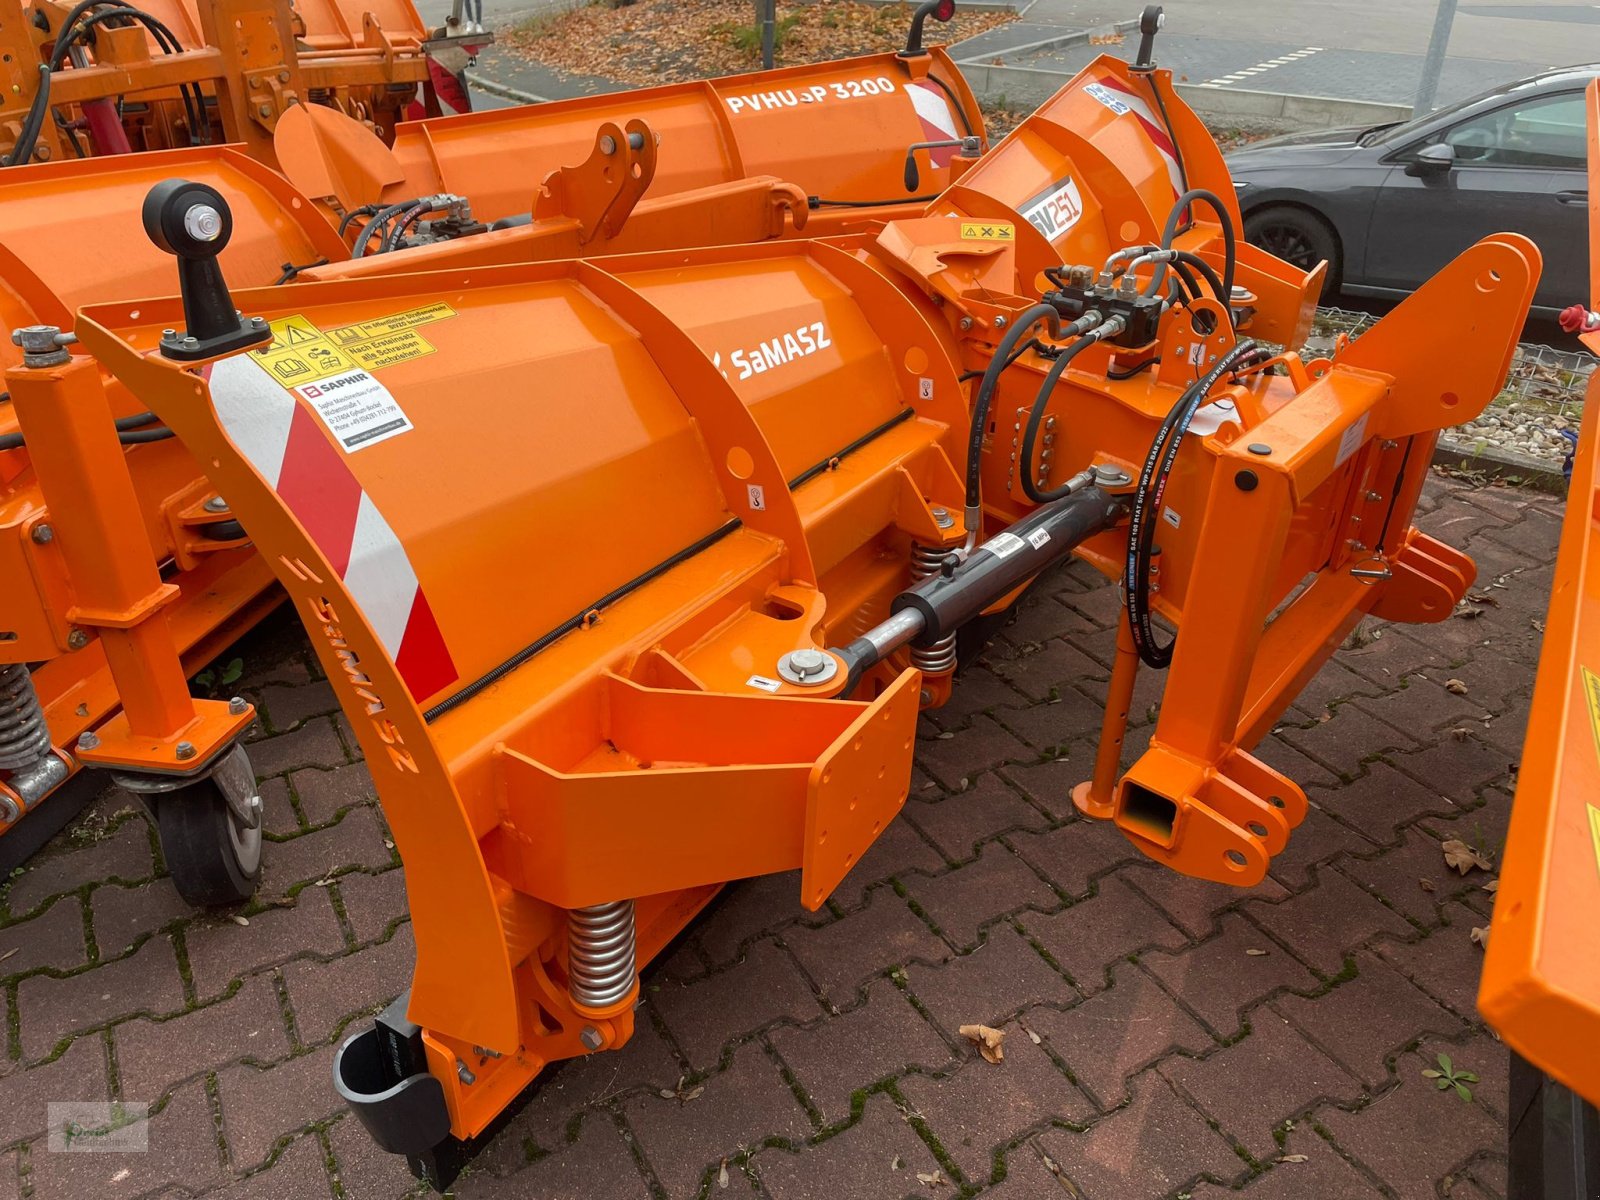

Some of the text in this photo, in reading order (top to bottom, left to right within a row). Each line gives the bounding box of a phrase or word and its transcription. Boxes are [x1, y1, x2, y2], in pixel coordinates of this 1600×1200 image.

[830, 76, 896, 100] 3200
[348, 332, 416, 355] Nach Ersteinsatz
[362, 340, 420, 361] alle Schrauben
[730, 322, 832, 380] SaMASZ
[375, 348, 422, 366] nachziehen!
[320, 373, 368, 392] SAPHIR
[318, 400, 334, 410] Saphir
[333, 390, 367, 406] Maschinenbau
[328, 412, 350, 424] D-27404
[334, 422, 350, 432] Phone
[1164, 460, 1172, 472] DIN
[1169, 448, 1176, 459] EN
[1174, 436, 1182, 448] 853
[1200, 382, 1210, 396] SAE
[1134, 505, 1142, 523] R1AT
[1142, 474, 1150, 486] WP
[1146, 461, 1154, 472] 215
[1150, 446, 1160, 460] BAR
